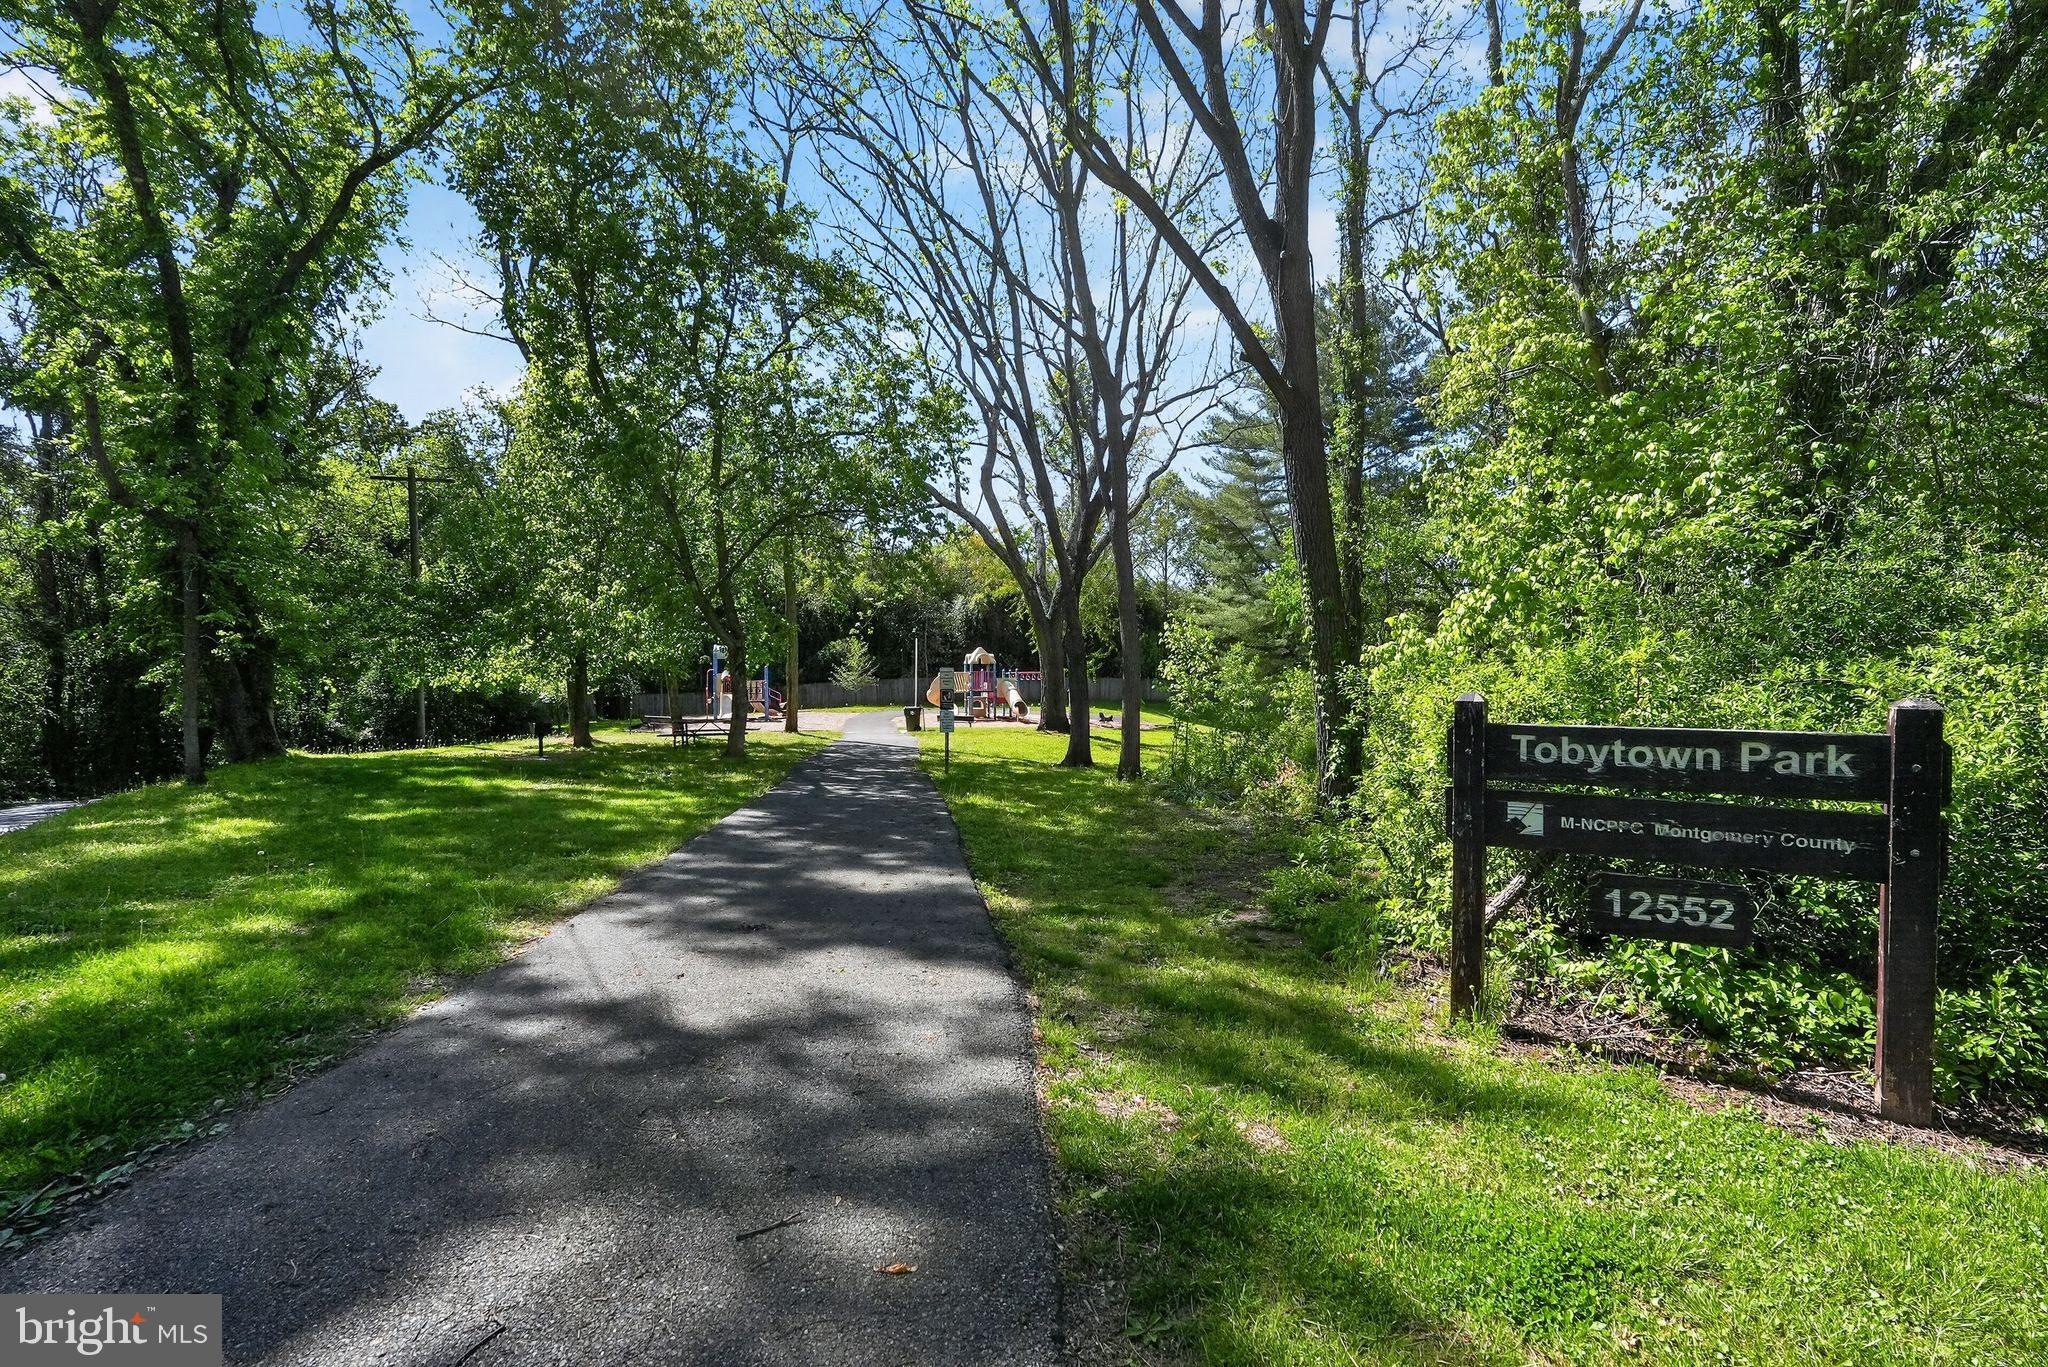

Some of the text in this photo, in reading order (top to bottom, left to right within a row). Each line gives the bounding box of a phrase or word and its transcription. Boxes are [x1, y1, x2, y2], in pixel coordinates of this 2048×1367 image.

[1511, 734, 1855, 777] Tobytown Park
[1654, 822, 1774, 848] Montgomery
[1780, 833, 1856, 855] County
[1605, 888, 1735, 931] 12552
